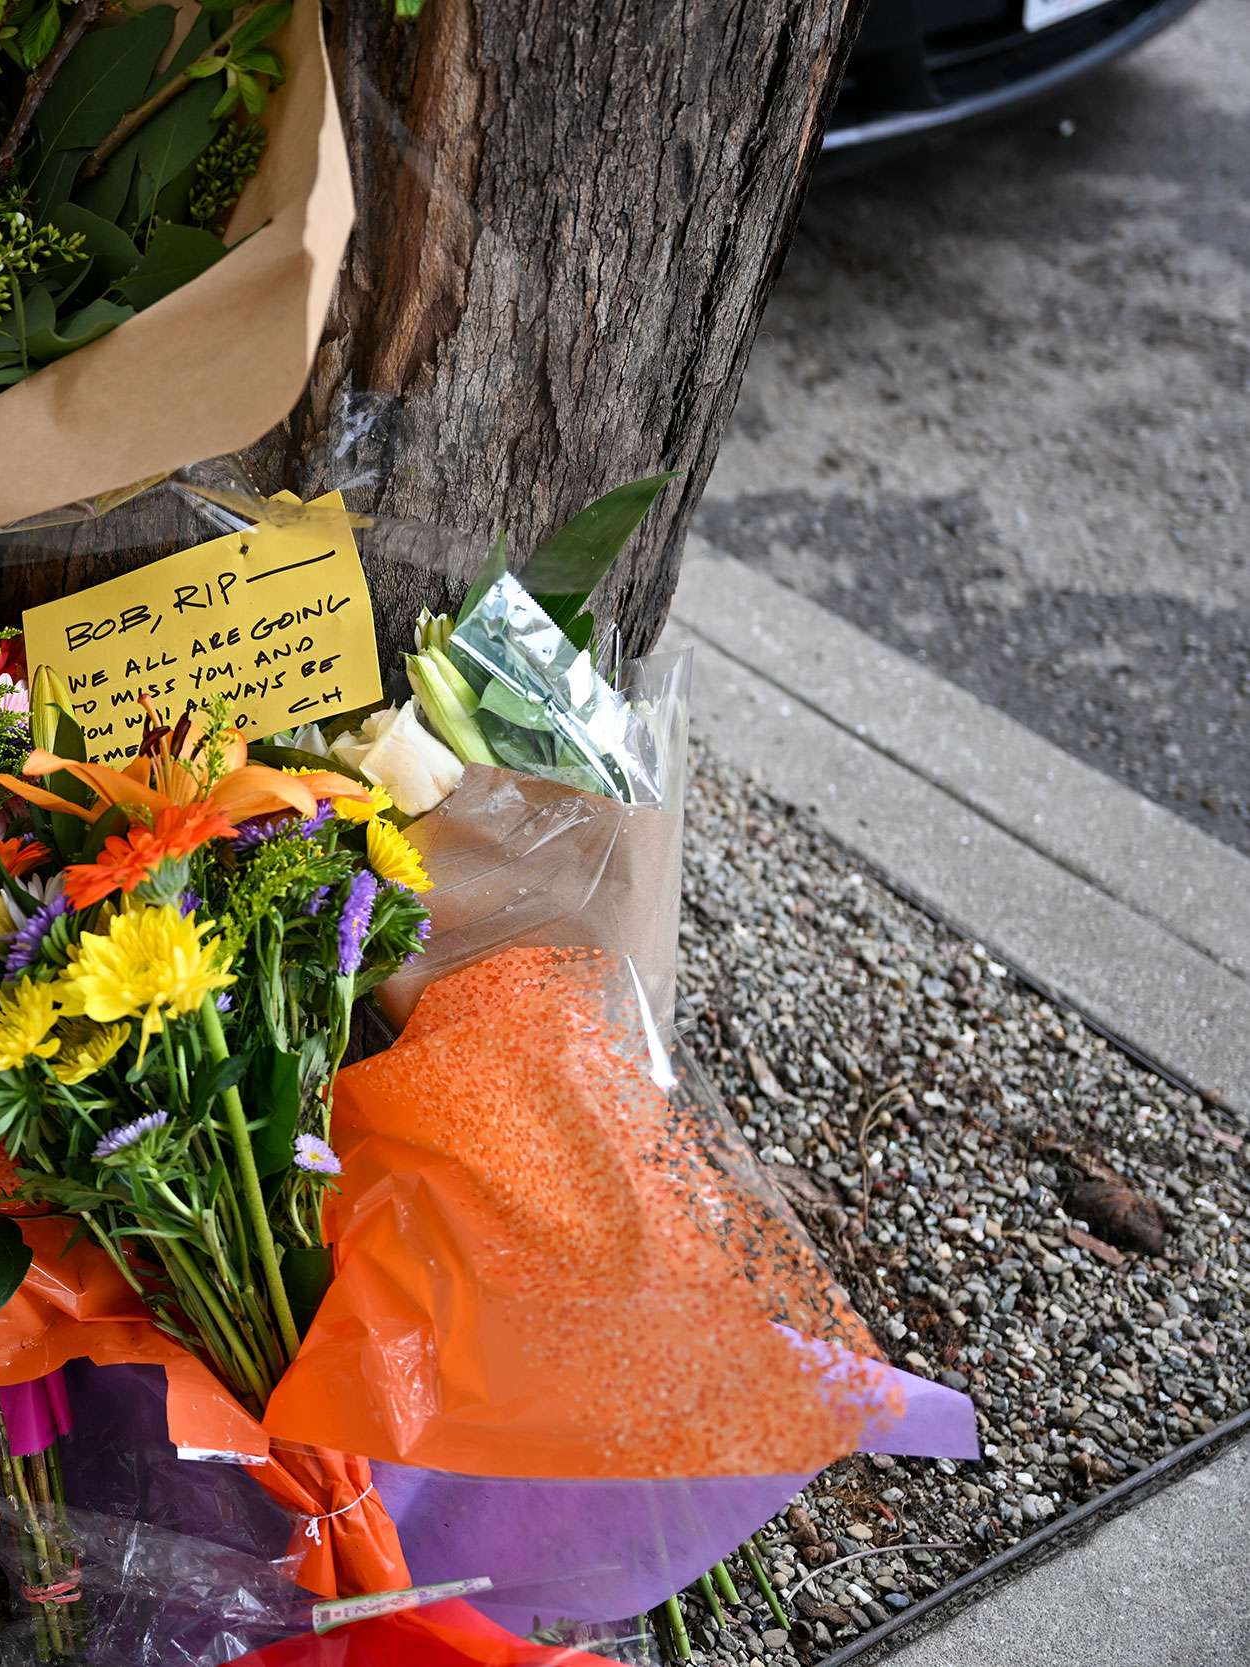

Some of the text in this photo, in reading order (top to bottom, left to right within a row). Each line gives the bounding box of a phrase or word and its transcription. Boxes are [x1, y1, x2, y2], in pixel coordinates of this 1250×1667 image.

[65, 605, 162, 651] BOB,
[68, 670, 109, 694] WE
[125, 652, 178, 678] ALL
[191, 627, 241, 657] ARE
[111, 678, 176, 707] MISS
[254, 636, 314, 668] AND
[301, 654, 342, 678] BE
[288, 686, 343, 714] CH
